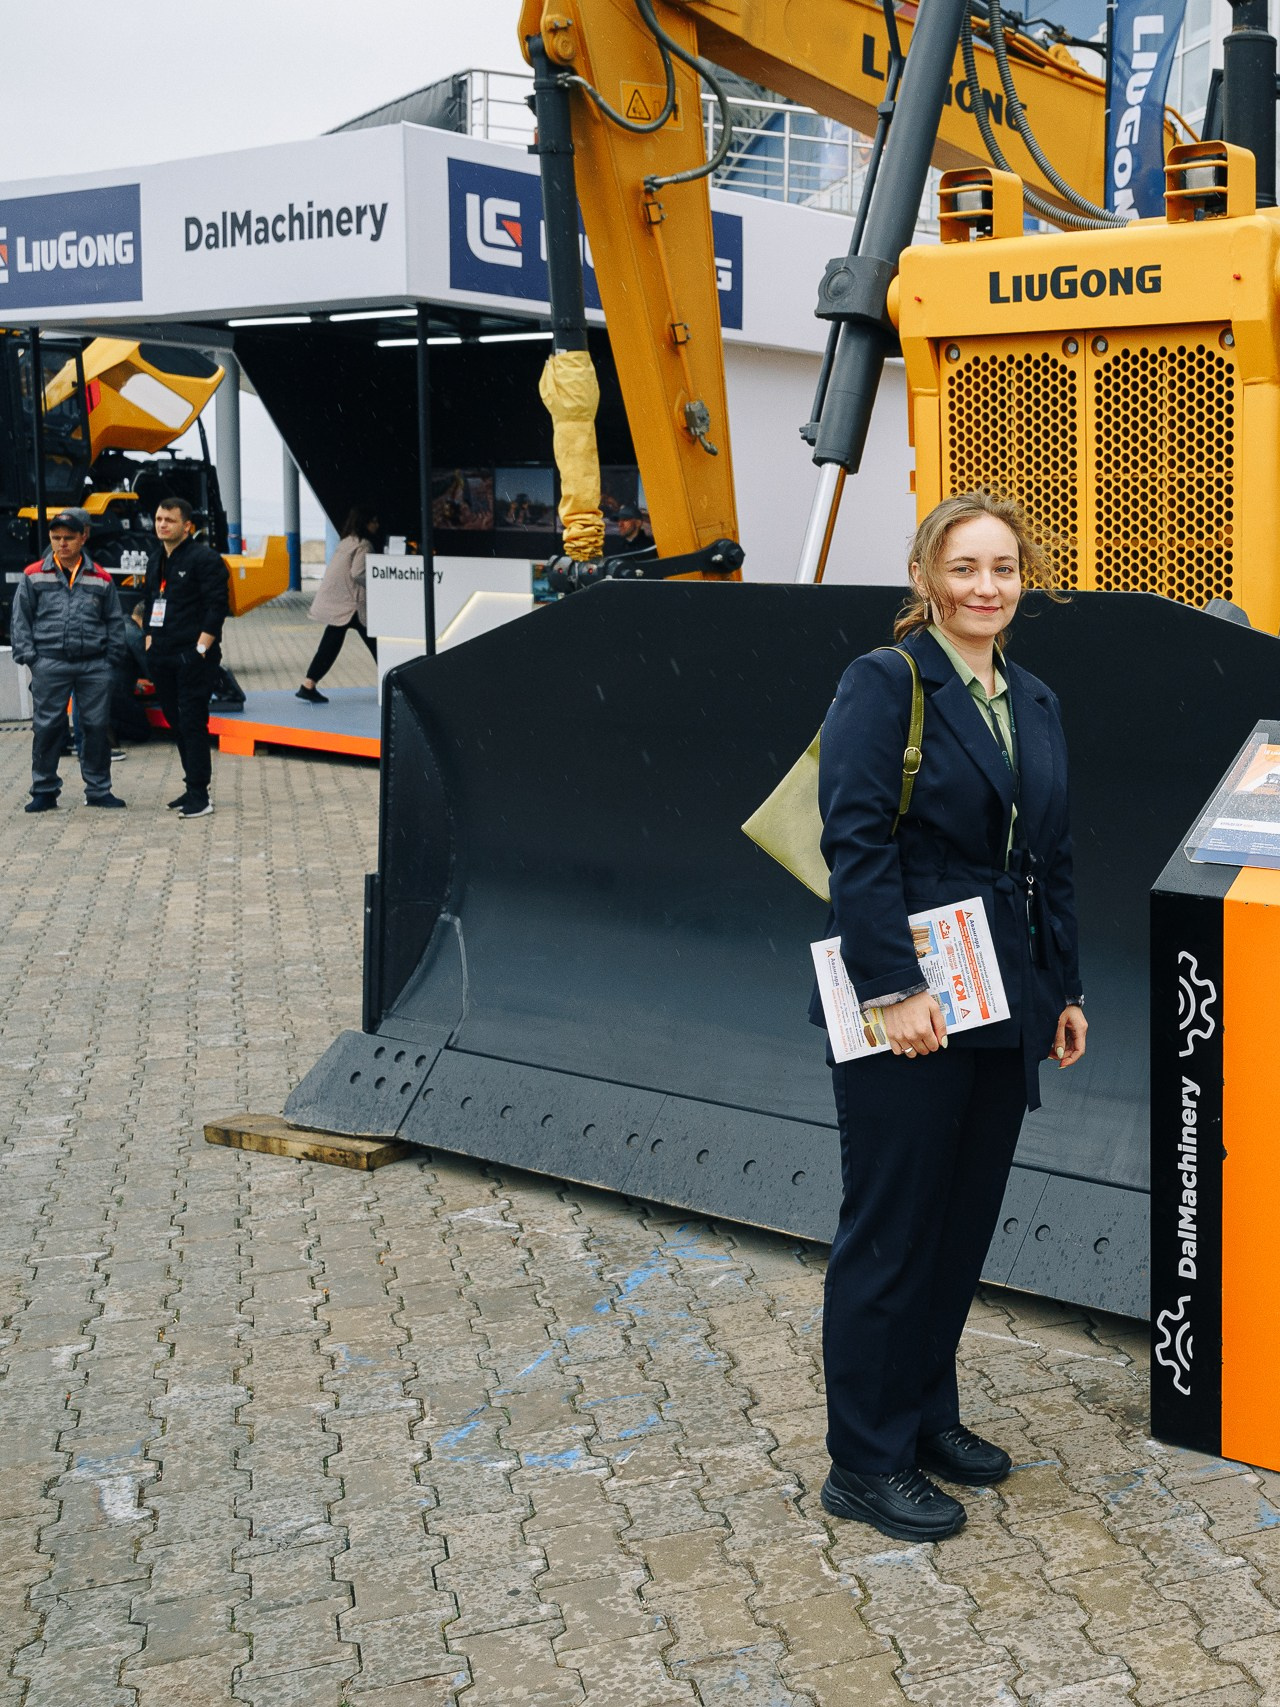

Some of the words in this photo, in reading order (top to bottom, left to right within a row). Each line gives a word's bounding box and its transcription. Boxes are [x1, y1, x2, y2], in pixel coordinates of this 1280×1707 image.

[1113, 15, 1165, 219] LIUGON
[185, 201, 388, 252] DalMachinery
[1177, 1075, 1201, 1281] DalMachinery
